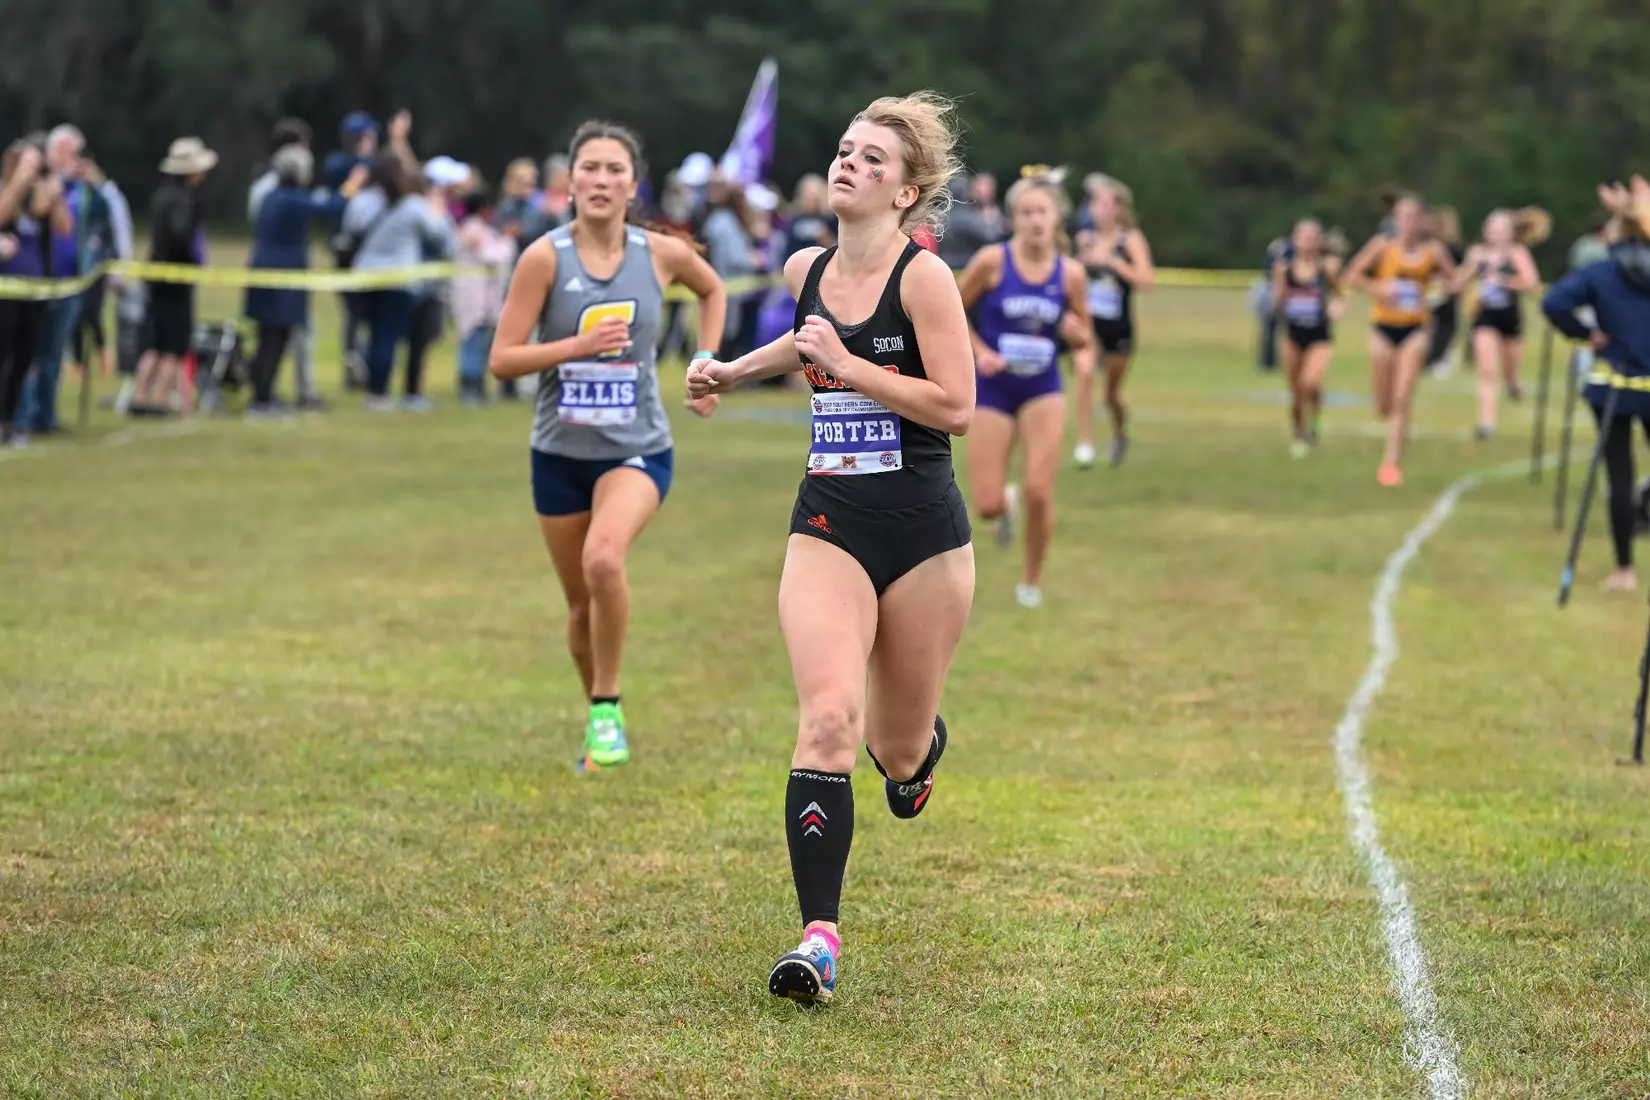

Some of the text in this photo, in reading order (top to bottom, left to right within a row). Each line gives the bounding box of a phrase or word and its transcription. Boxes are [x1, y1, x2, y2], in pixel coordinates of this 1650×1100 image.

[561, 381, 636, 406] ELLIS
[813, 419, 897, 443] PORTER
[791, 771, 846, 782] RYMORA
